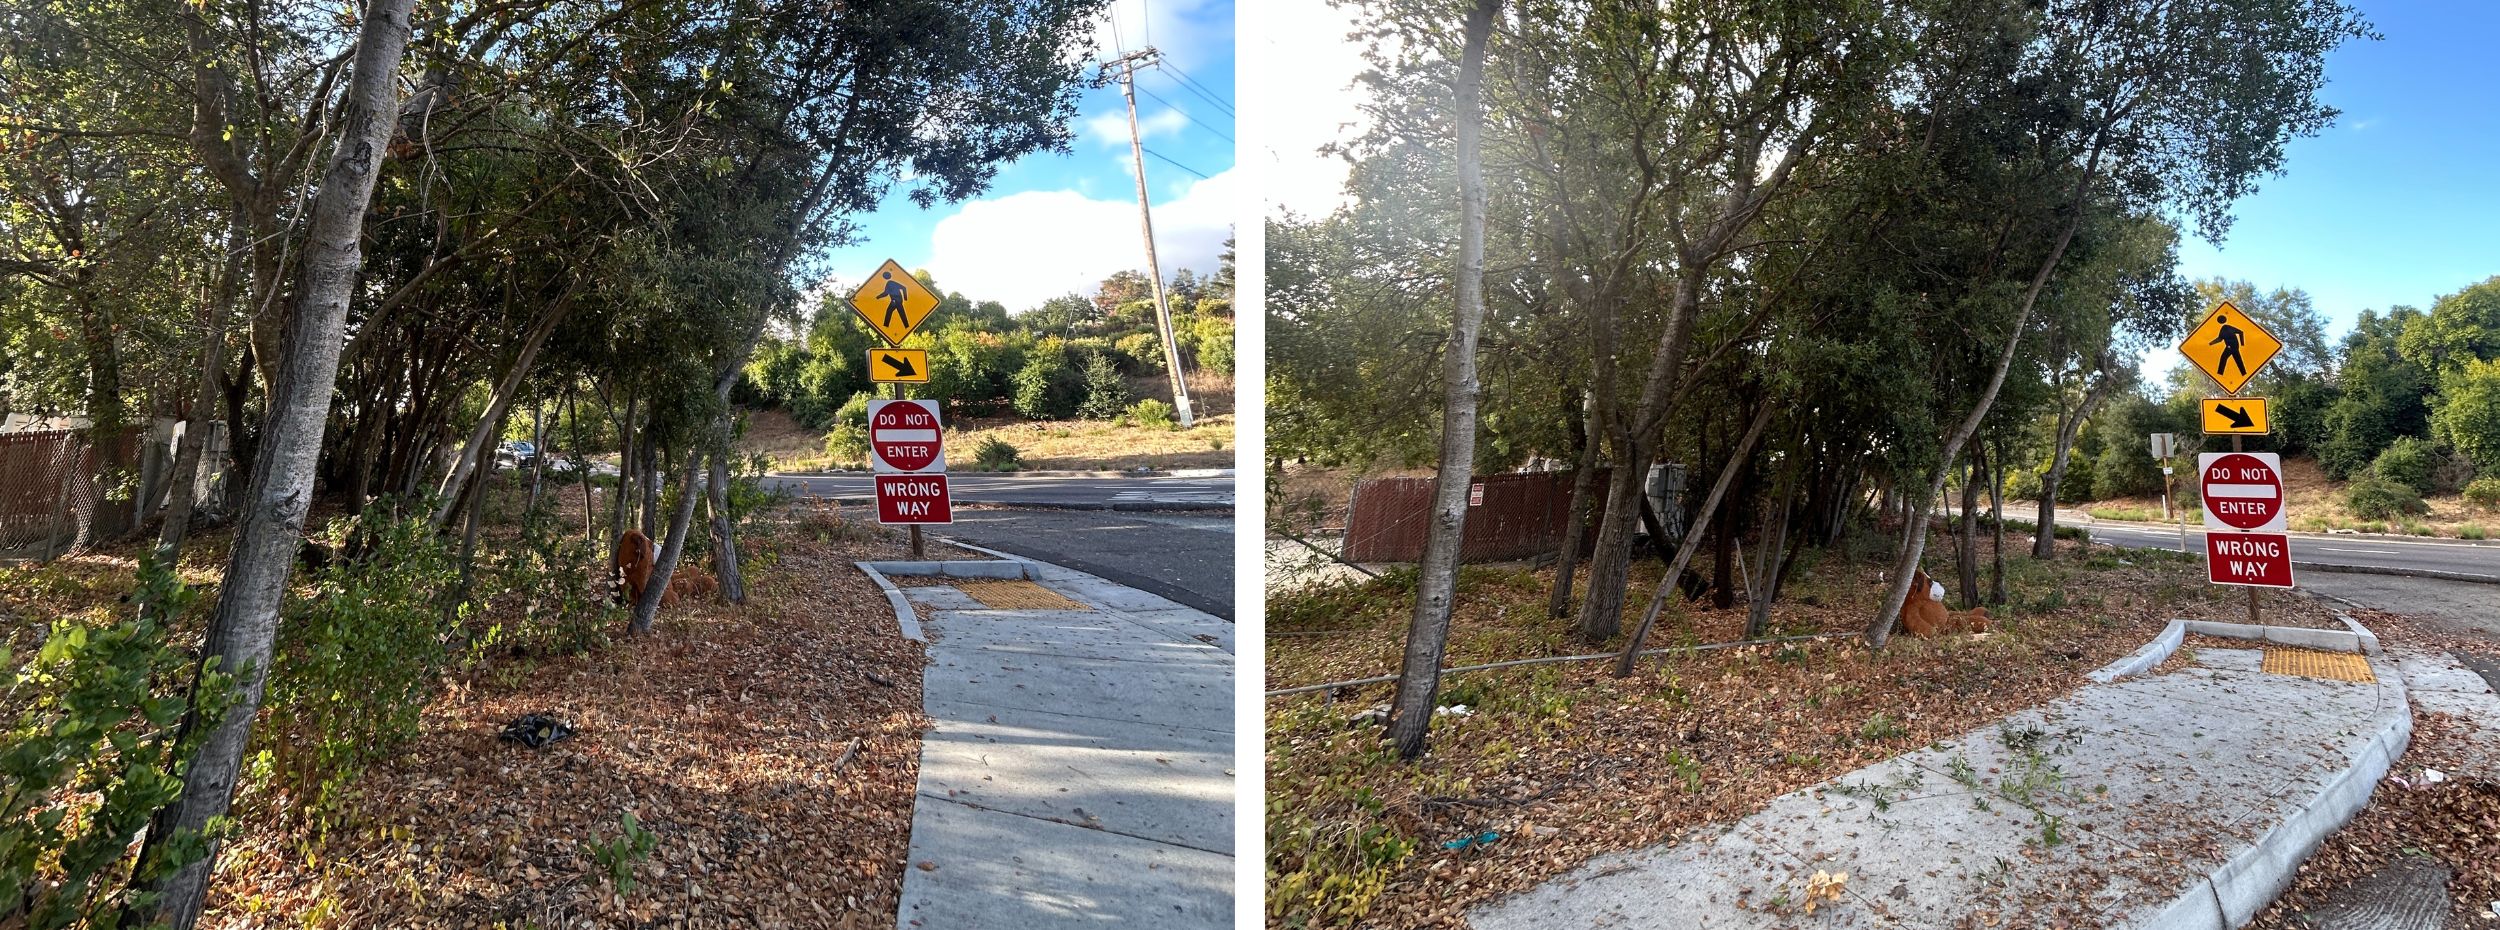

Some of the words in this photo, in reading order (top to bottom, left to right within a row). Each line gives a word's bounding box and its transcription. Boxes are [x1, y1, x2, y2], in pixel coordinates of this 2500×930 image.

[880, 414, 896, 426] DO
[905, 414, 930, 426] NOT
[887, 445, 929, 458] ENTER
[2211, 467, 2231, 480] DO
[2241, 467, 2268, 481] NOT
[884, 482, 940, 497] WRONG
[897, 501, 931, 516] WAY
[2219, 501, 2267, 515] ENTER
[2215, 540, 2280, 558] WRONG
[2230, 560, 2268, 577] WAY
